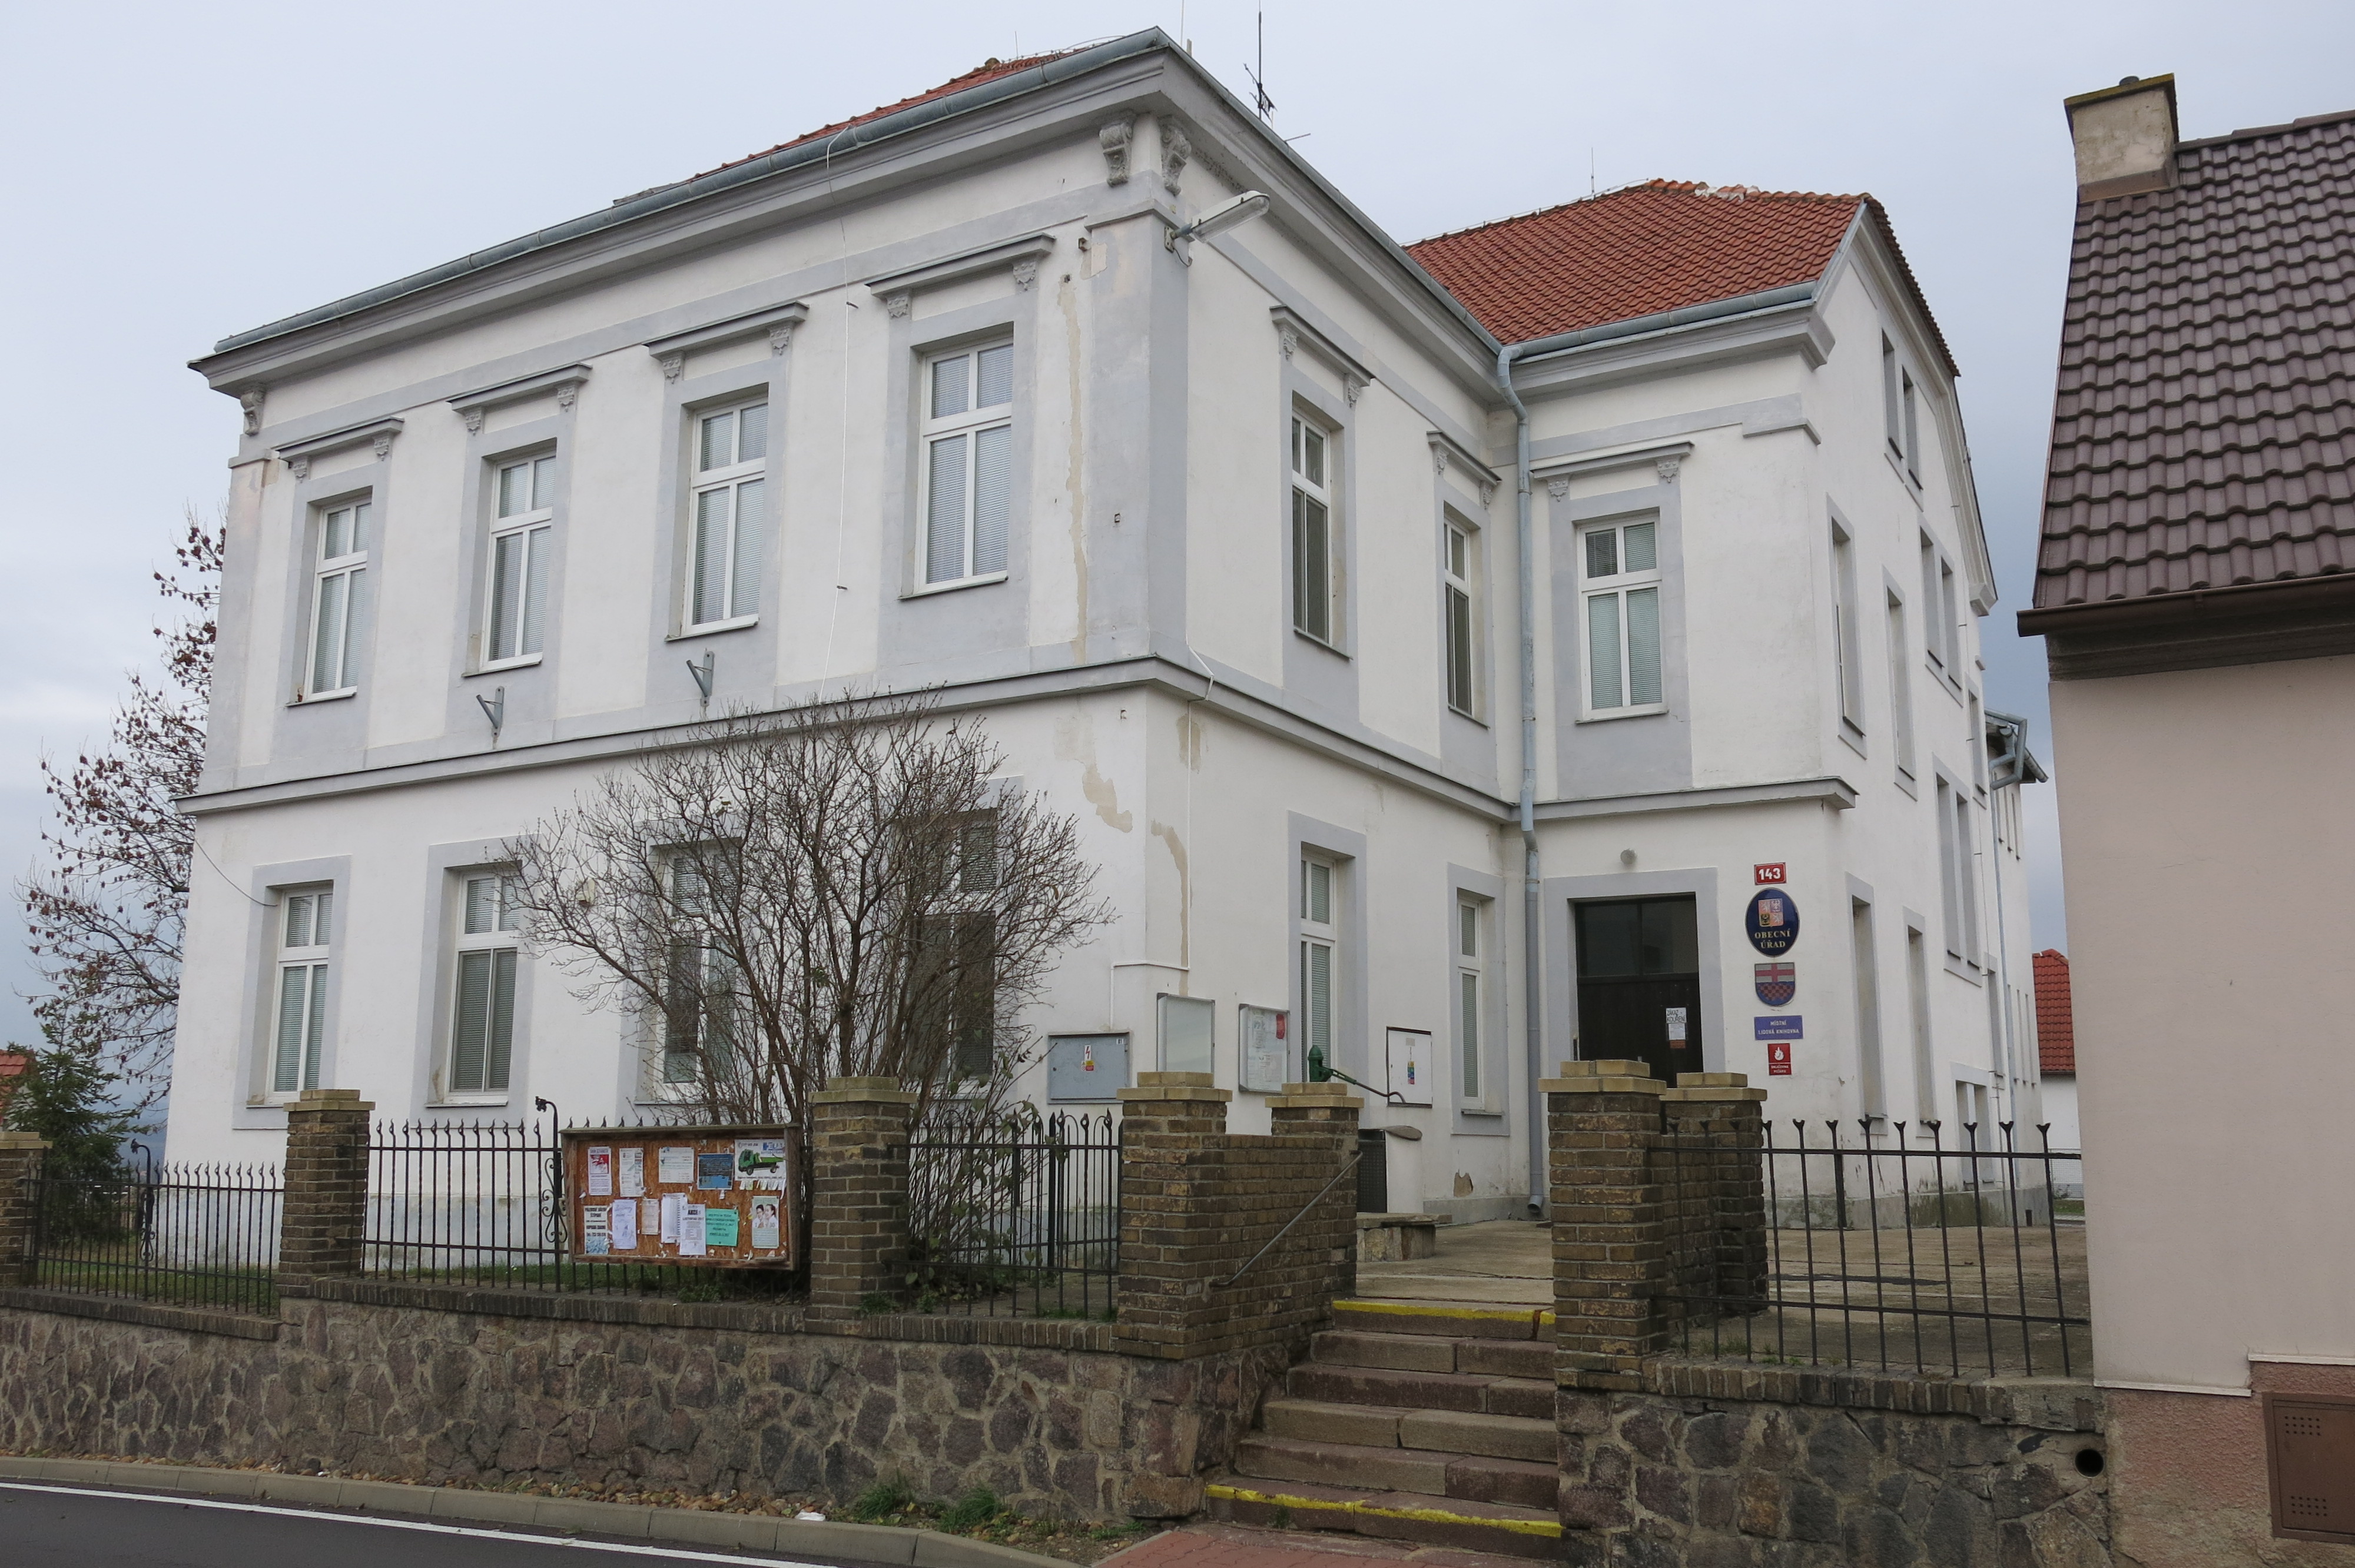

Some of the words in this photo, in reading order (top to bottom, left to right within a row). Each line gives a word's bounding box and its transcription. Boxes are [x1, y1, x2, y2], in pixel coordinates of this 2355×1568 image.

[1759, 868, 1781, 881] 143
[1754, 928, 1790, 939] OBECNÍ
[1760, 939, 1786, 949] ÚŘAD
